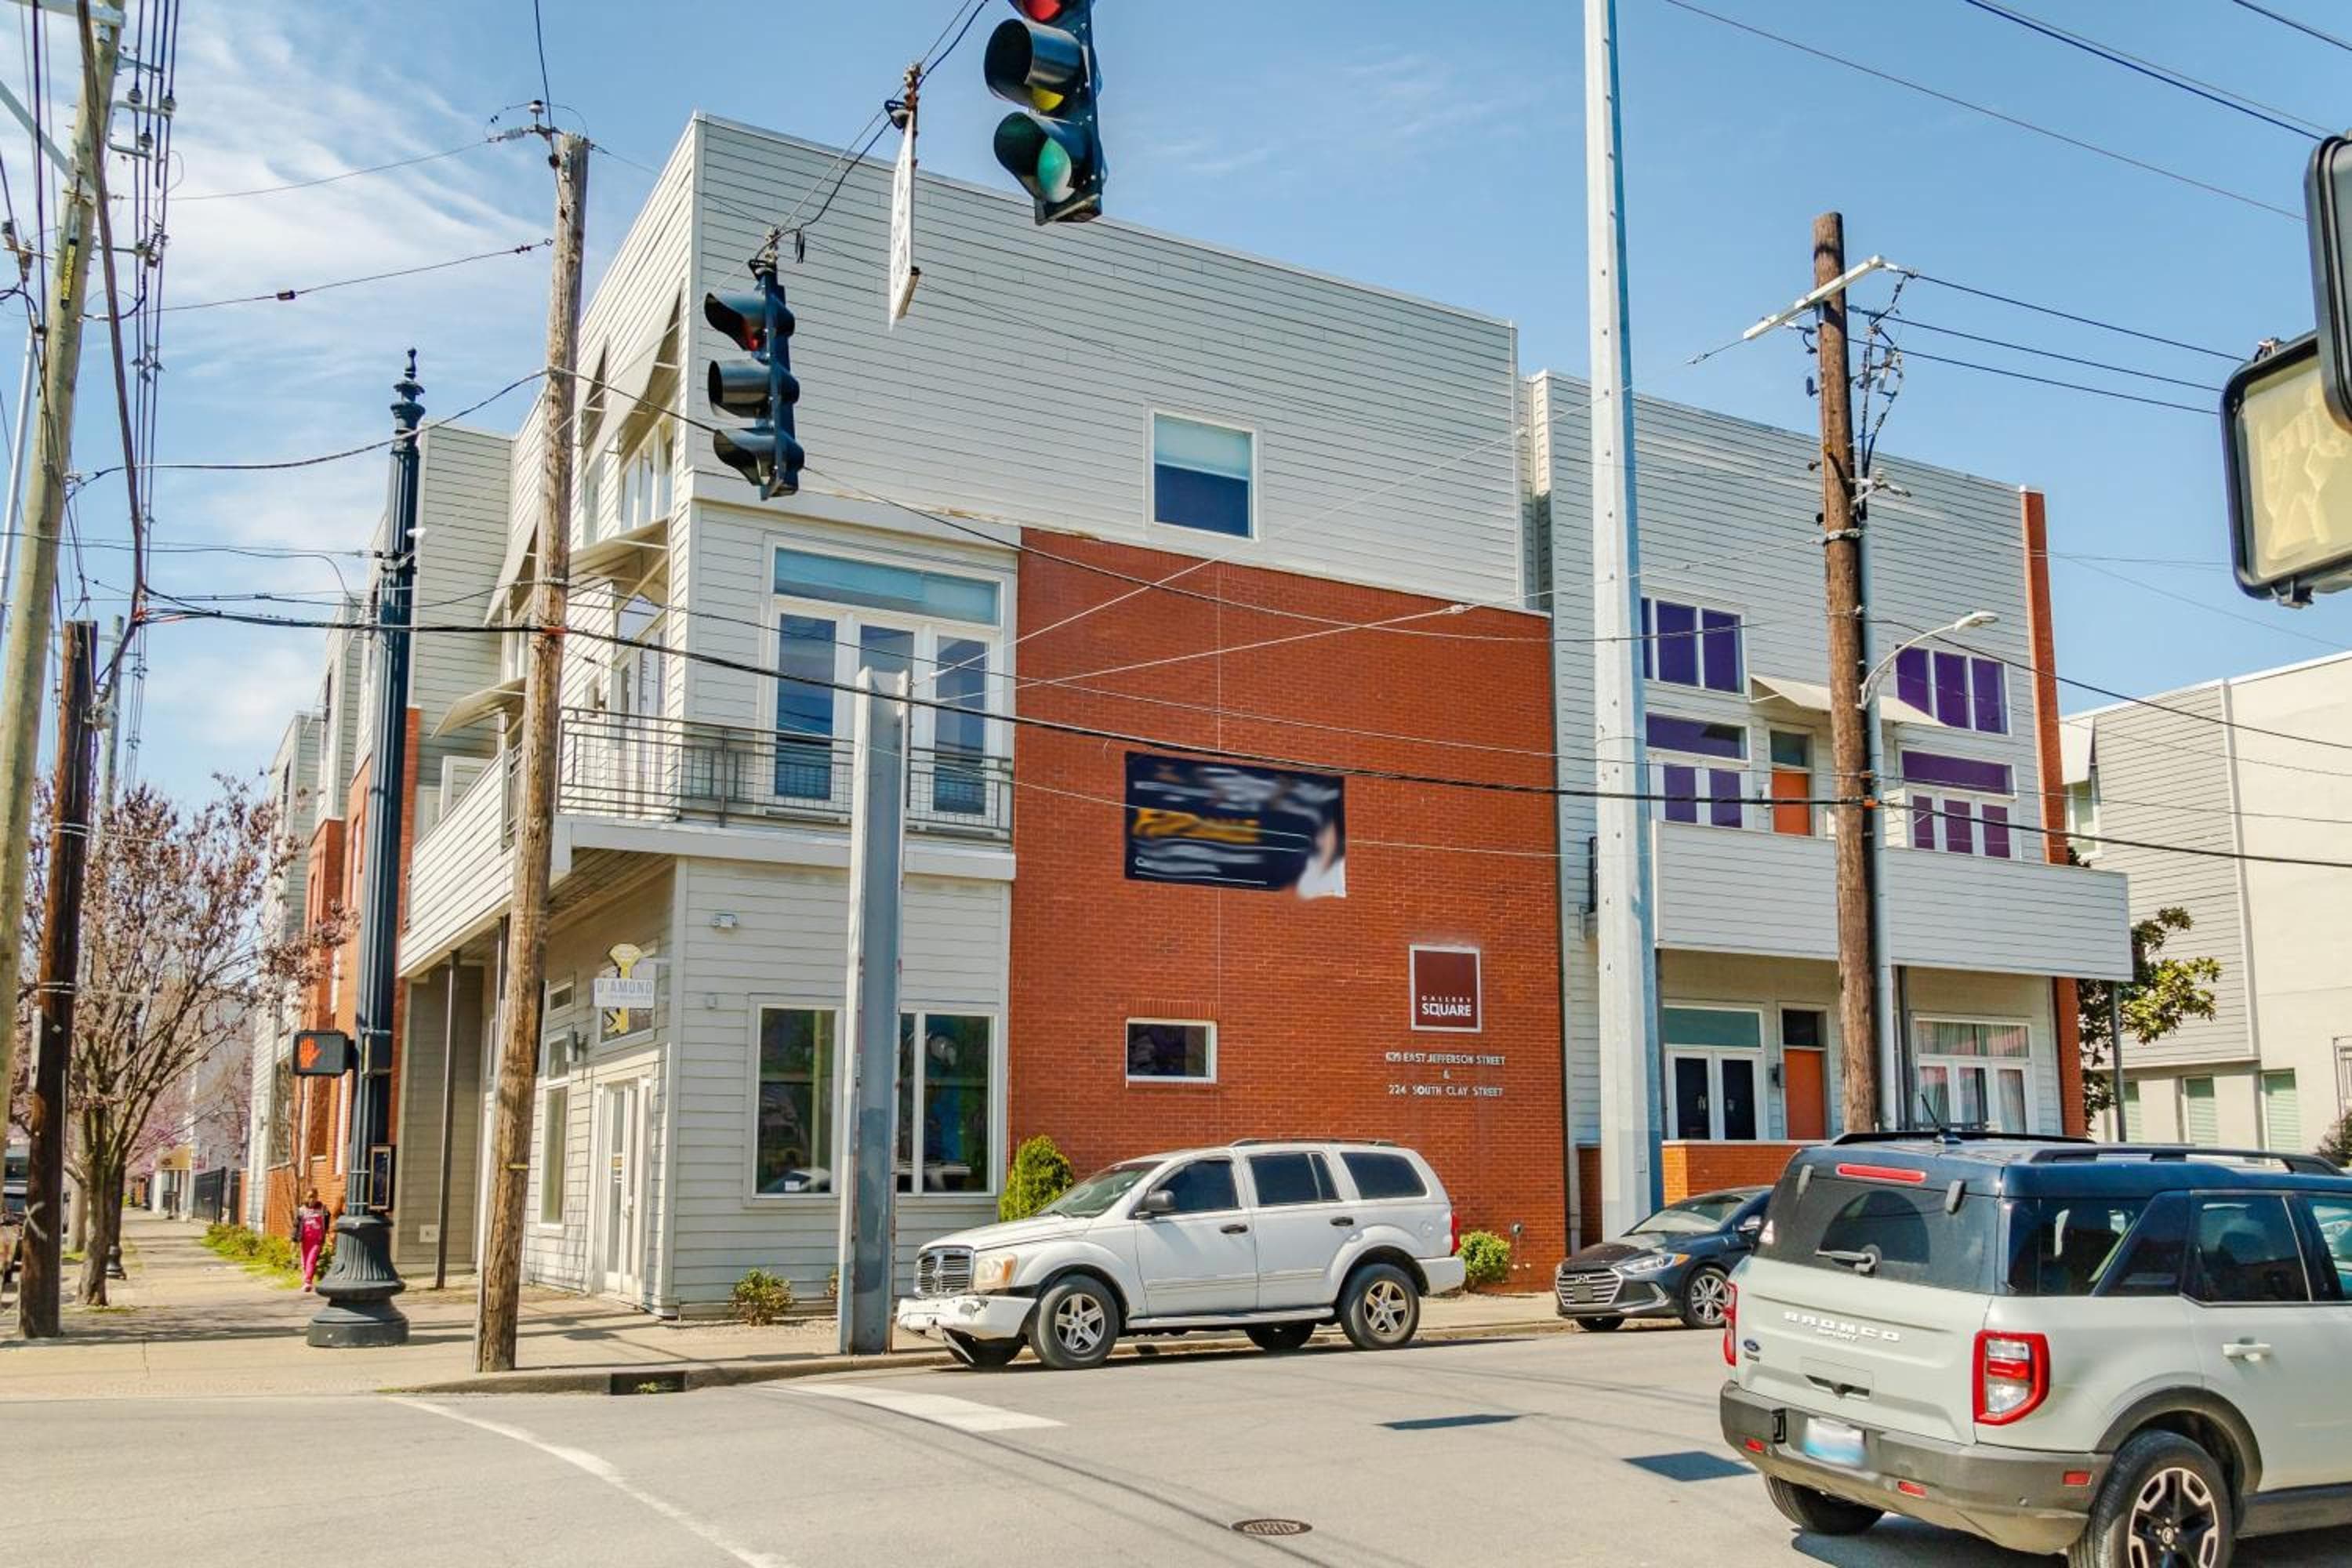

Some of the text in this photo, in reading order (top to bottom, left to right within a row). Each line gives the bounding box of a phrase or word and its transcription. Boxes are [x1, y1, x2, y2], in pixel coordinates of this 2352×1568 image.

[1421, 1004, 1472, 1017] SQUARE
[1403, 1052, 1426, 1062] EAST
[1427, 1053, 1474, 1064] JEFFERSON
[1476, 1054, 1505, 1065] STREET
[1443, 1069, 1450, 1080] &
[1388, 1084, 1504, 1097] 224 SOUTH CLAY STREET
[1784, 1311, 1900, 1342] BRONCO
